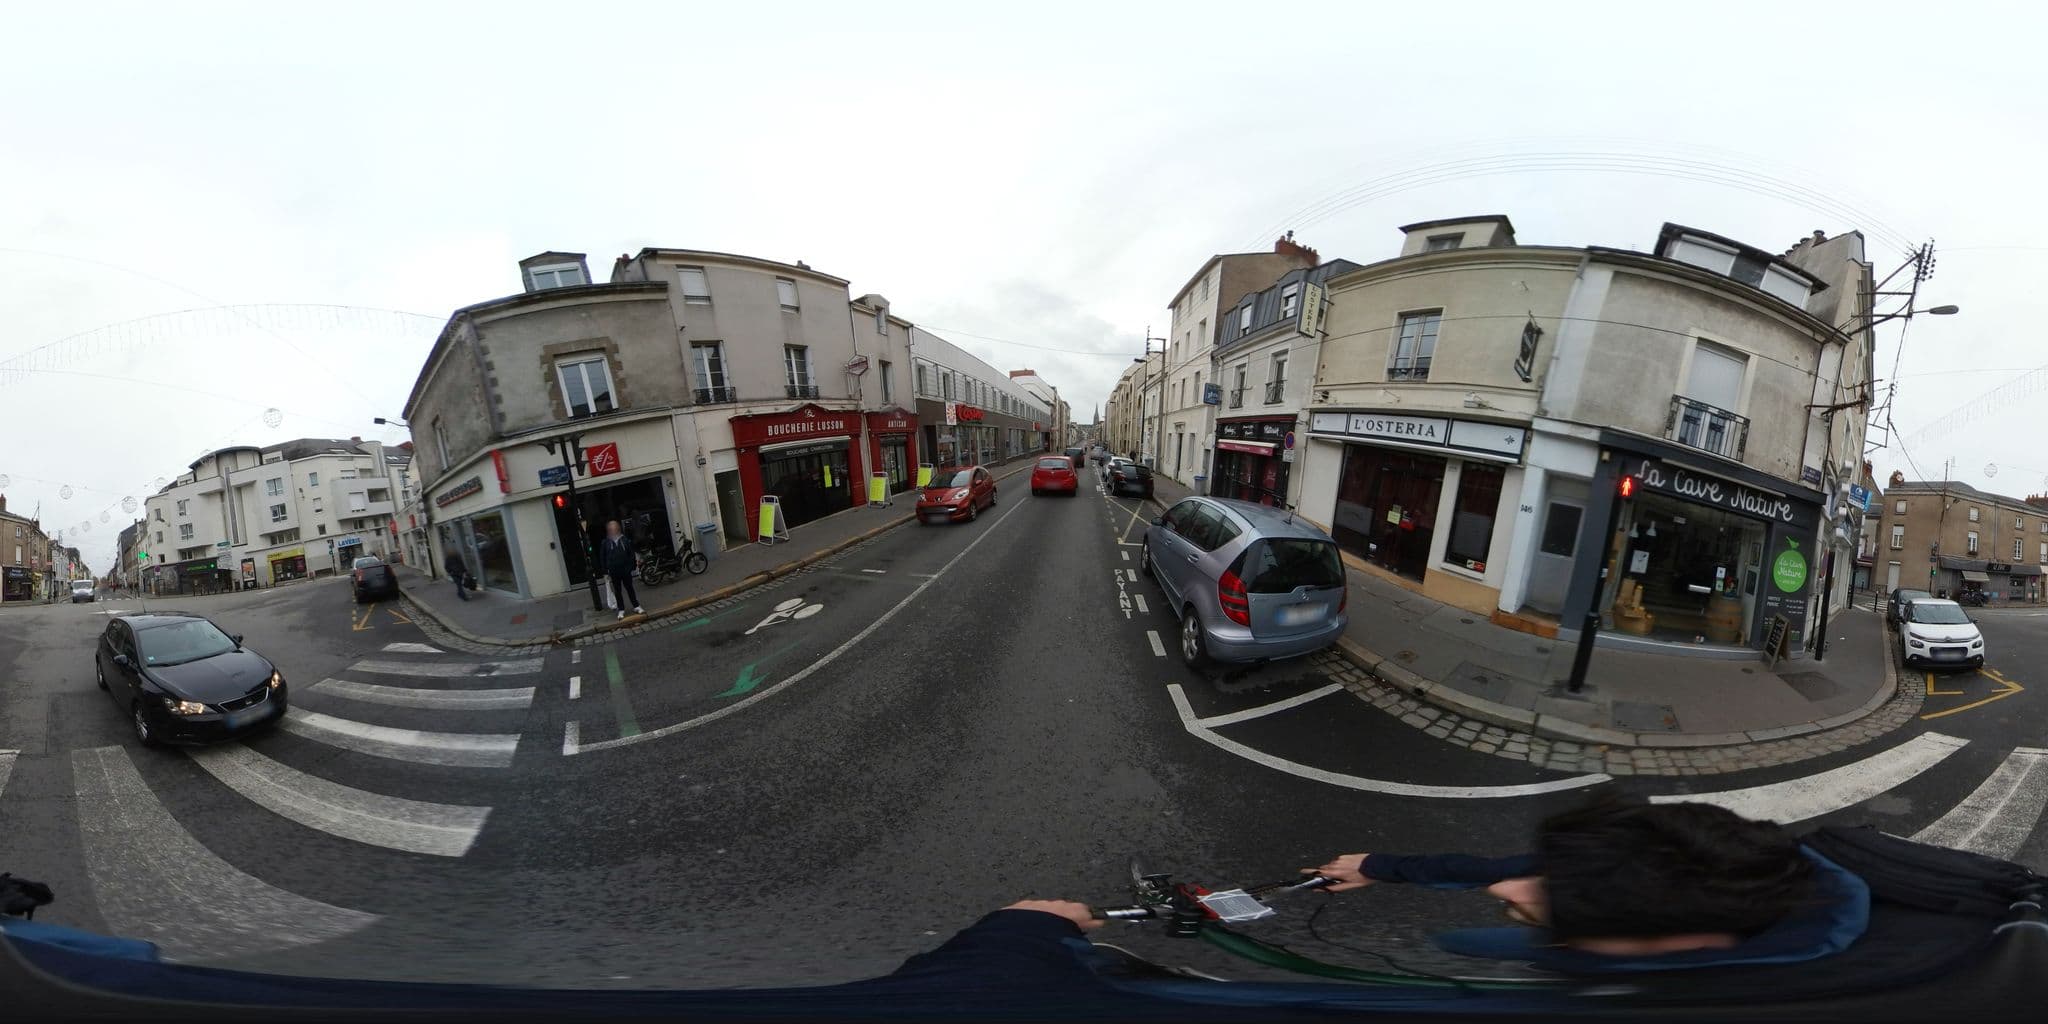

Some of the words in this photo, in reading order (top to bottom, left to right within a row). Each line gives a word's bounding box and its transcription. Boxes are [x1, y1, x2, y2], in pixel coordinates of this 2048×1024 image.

[767, 421, 814, 436] BOUCHERIE
[817, 419, 844, 431] LUSSON
[1354, 418, 1436, 438] L'OSTERIA
[1634, 459, 1666, 488] La
[1673, 469, 1724, 502] Cave
[1730, 487, 1794, 522] Nature
[1114, 568, 1133, 619] PAYANT
